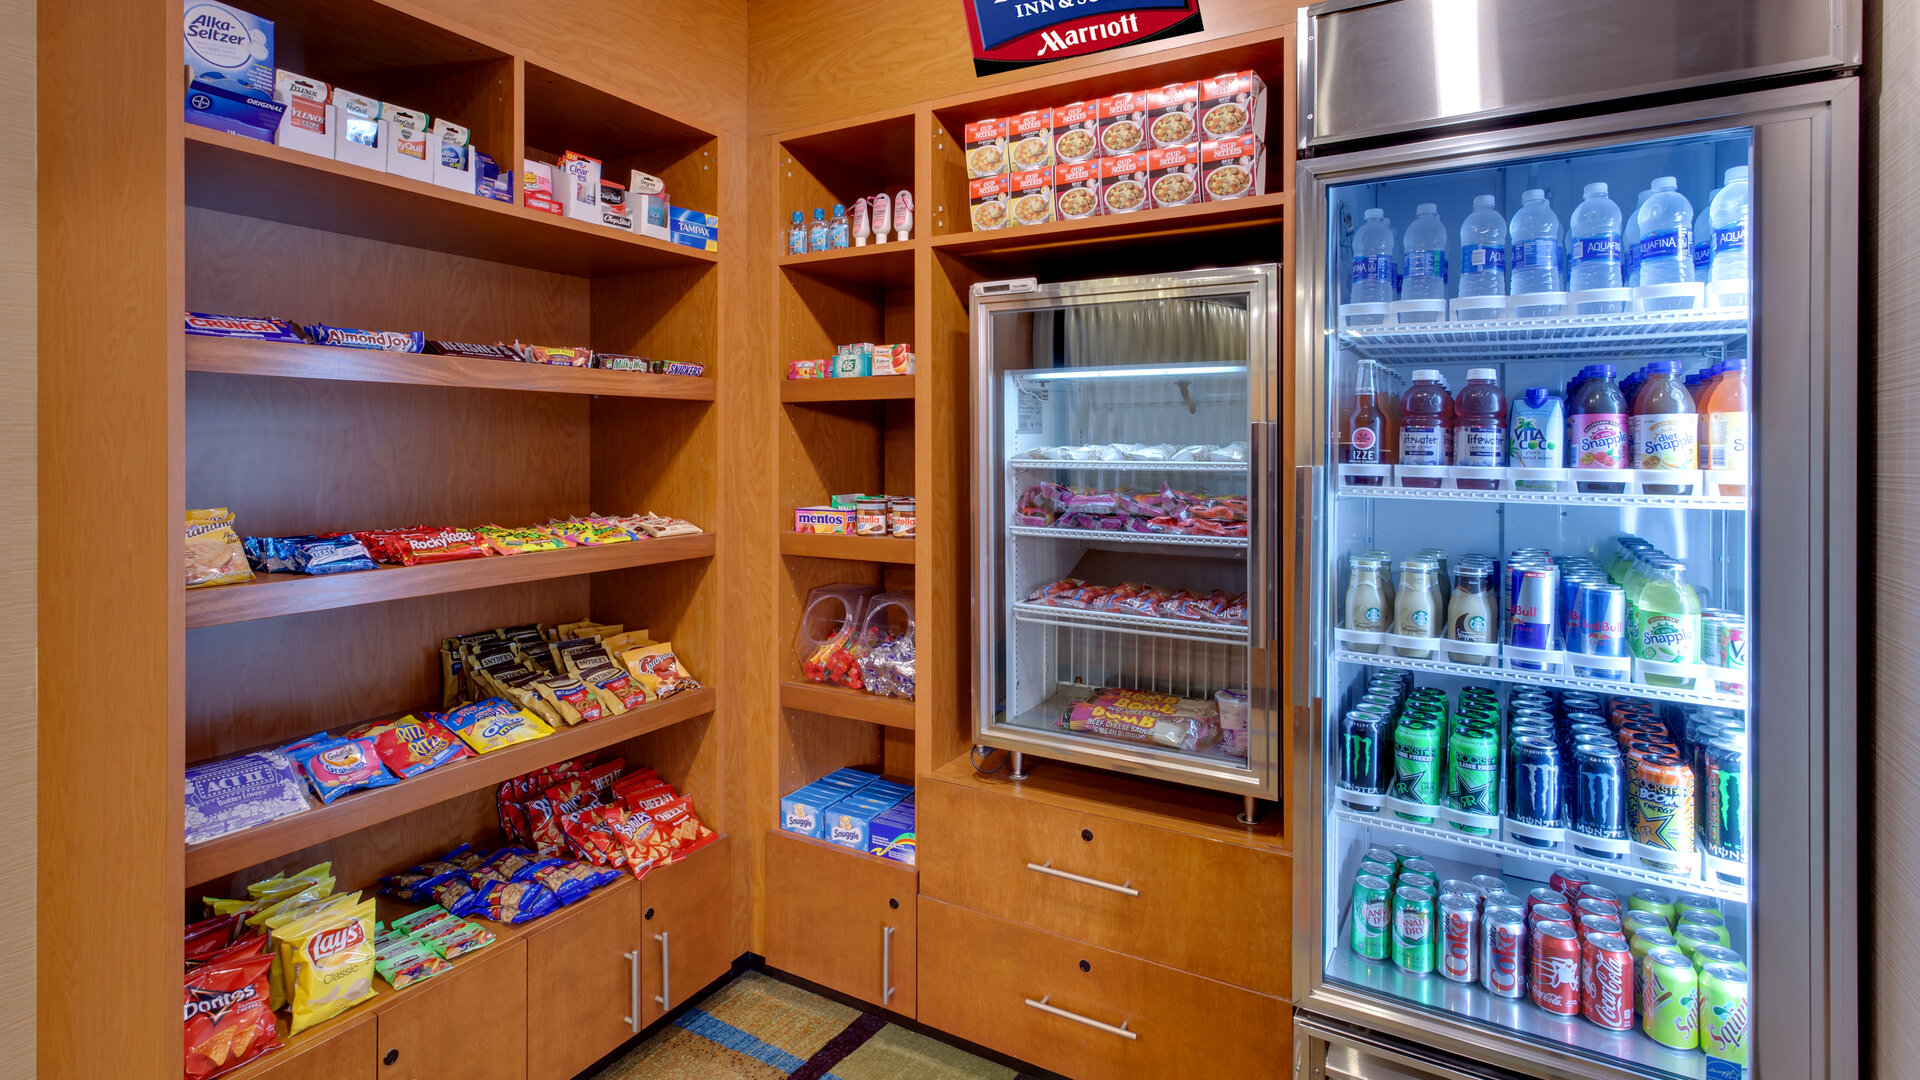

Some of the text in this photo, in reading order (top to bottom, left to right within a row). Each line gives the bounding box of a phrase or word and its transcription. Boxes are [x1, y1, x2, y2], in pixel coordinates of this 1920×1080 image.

[1014, 0, 1055, 18] INN
[191, 14, 236, 31] Alka-
[187, 25, 245, 45] Seltzer
[1037, 13, 1139, 56] Marriott
[246, 97, 283, 113] ORIGINAL
[1109, 103, 1135, 114] NOODLES
[1115, 98, 1130, 107] CUP
[1063, 113, 1087, 123] NOODLES
[1068, 108, 1082, 116] CUP
[1018, 122, 1041, 131] NOODLES
[975, 130, 997, 139] NOODLES
[1214, 147, 1242, 157] NOODLES
[1220, 142, 1236, 150] CUP
[1160, 155, 1186, 166] NOODLES
[1166, 150, 1181, 159] CUP
[1112, 163, 1137, 173] NOODLES
[1117, 159, 1131, 167] CUP
[569, 164, 589, 176] Clear
[1065, 171, 1089, 180] NOODLES
[641, 179, 655, 188] Degree
[1020, 178, 1042, 187] NOODLES
[979, 185, 999, 195] NOODLES
[679, 222, 709, 237] TAMPAX
[1640, 236, 1676, 252] QUAFINA
[189, 318, 278, 332] CRUNCH
[326, 329, 411, 351] Almond Joy
[438, 340, 512, 356] HERSHEY'S
[613, 358, 648, 373] Milky Way
[669, 363, 703, 377] SNICKERS
[1514, 428, 1546, 441] VITA
[1658, 432, 1678, 443] diet
[1581, 430, 1627, 452] Snapple
[1353, 450, 1375, 460] IZZE
[798, 514, 843, 525] mentos
[1600, 621, 1622, 633] Bull
[1643, 628, 1693, 646] Snapple
[482, 652, 514, 667] SNYDER'S
[579, 655, 608, 667] SNYDER'S
[612, 679, 626, 688] Mini
[568, 692, 584, 701] Mini
[1087, 717, 1154, 736] BEEF, CHEESE SAUCE
[1100, 728, 1118, 737] BEAN
[397, 725, 426, 743] RITZ
[410, 735, 440, 755] RITZ
[326, 744, 354, 761] Goldfish
[324, 759, 367, 775] Grahams
[206, 769, 266, 793] ACT II
[217, 789, 267, 807] Butter Lovers
[1644, 802, 1676, 814] ENERGY
[613, 811, 653, 841] BUGLES
[789, 816, 813, 828] Snuggle
[834, 829, 860, 841] Snuggle
[1405, 926, 1424, 935] DRY
[1444, 913, 1469, 977] Coke
[1491, 926, 1517, 992] Coke
[323, 964, 359, 985] Classic
[1532, 984, 1563, 1007] Coca-Cola
[184, 983, 255, 1021] Doritos
